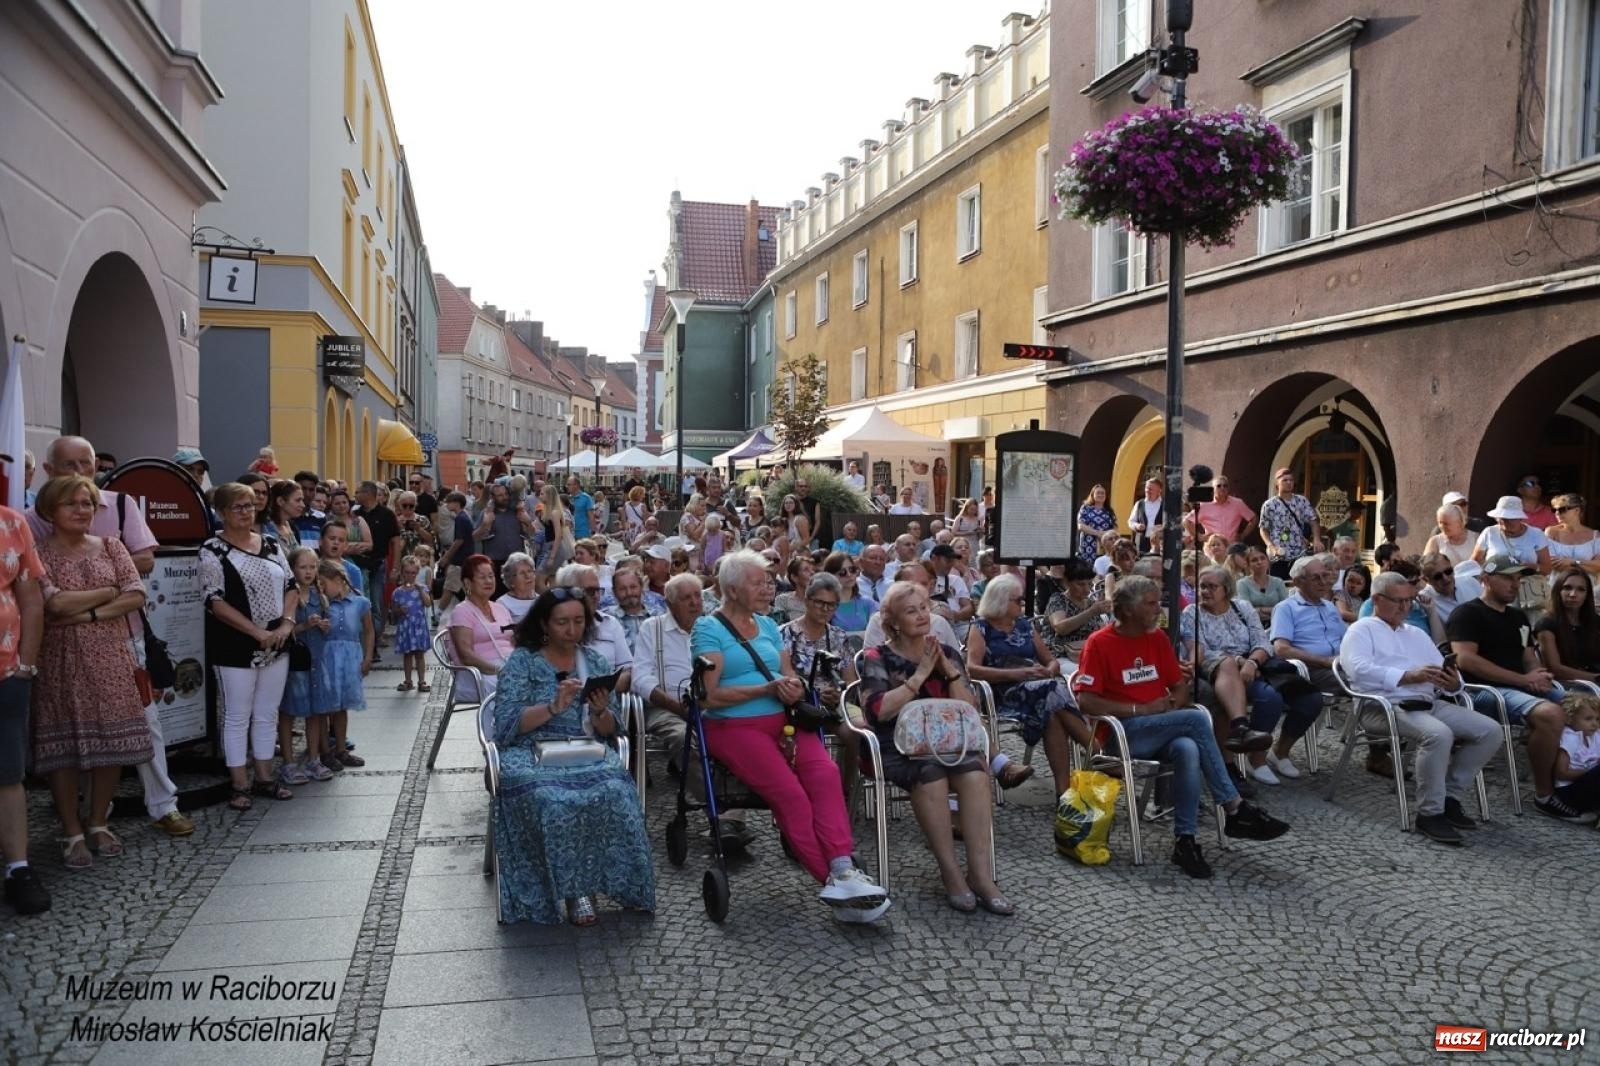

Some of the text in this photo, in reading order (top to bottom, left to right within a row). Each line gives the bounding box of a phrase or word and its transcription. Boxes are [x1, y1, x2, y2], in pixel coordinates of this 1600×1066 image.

[326, 344, 361, 352] JUBILER
[149, 502, 179, 510] Muzeum
[156, 511, 190, 520] Raciborzu
